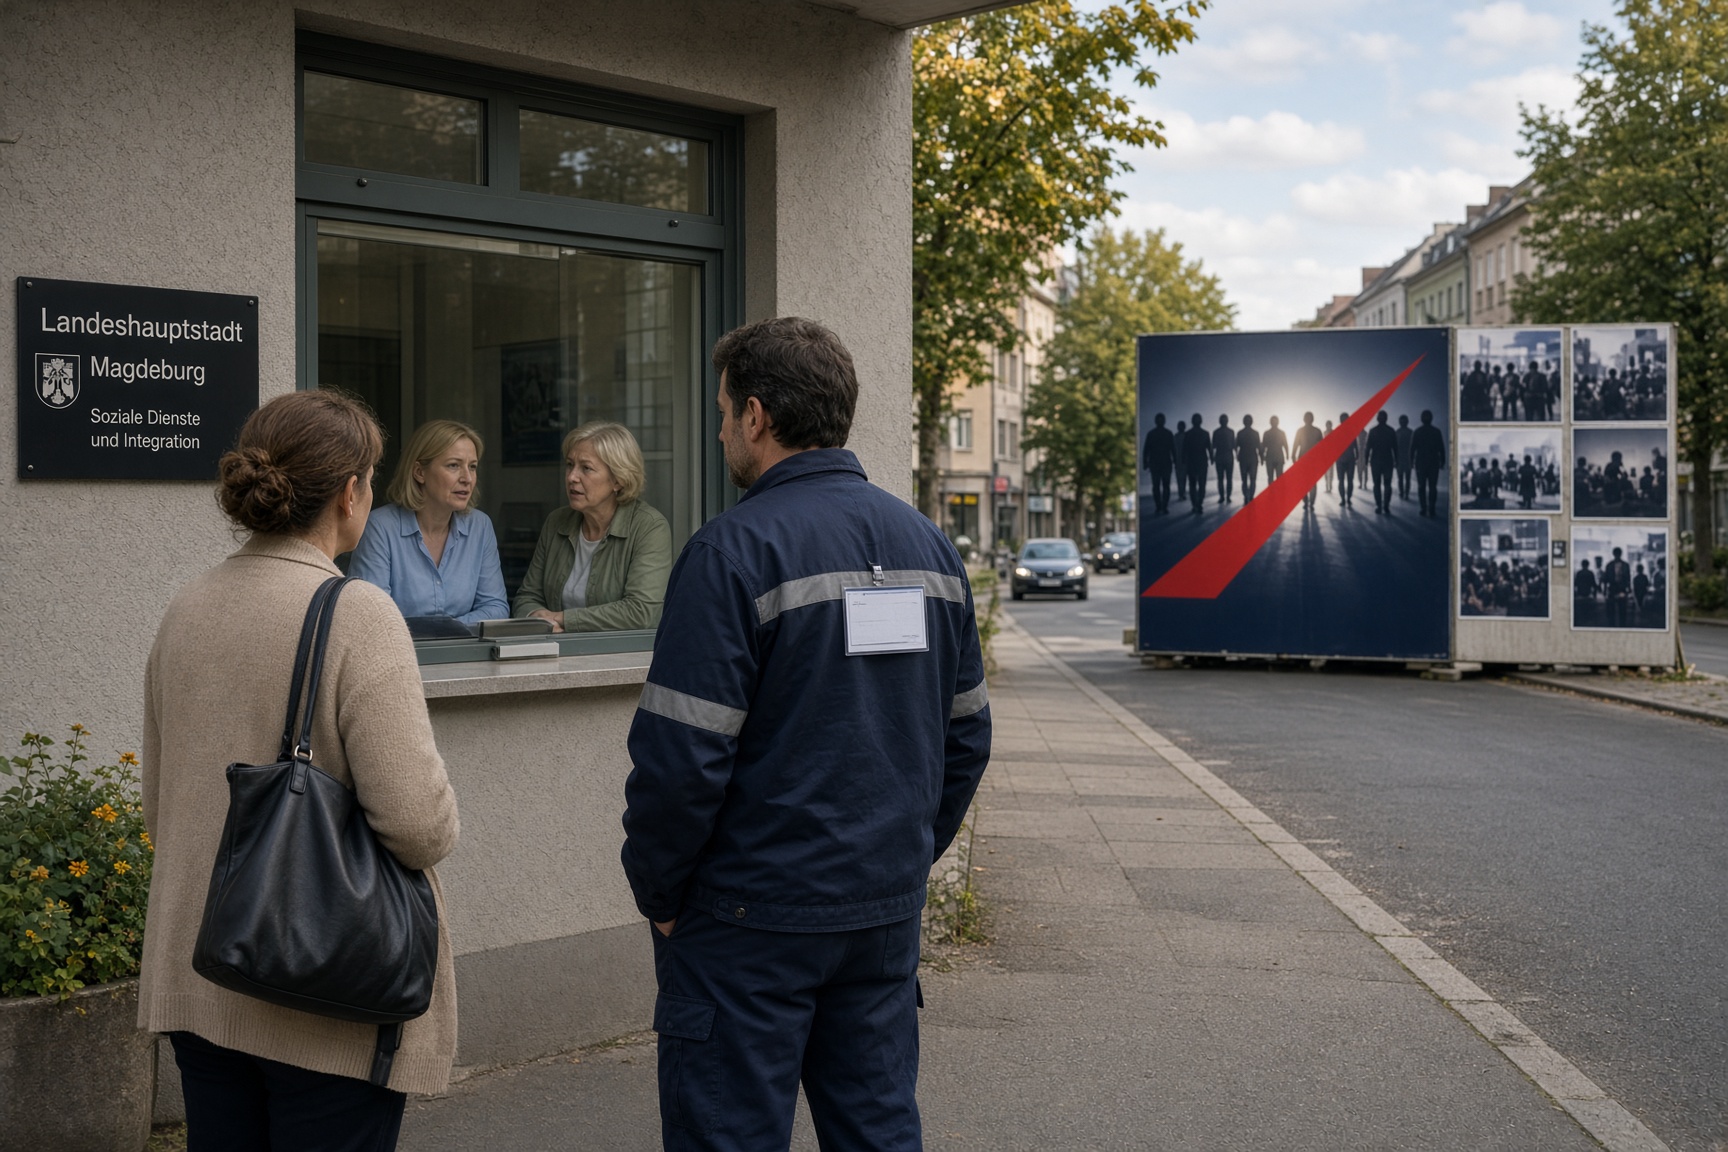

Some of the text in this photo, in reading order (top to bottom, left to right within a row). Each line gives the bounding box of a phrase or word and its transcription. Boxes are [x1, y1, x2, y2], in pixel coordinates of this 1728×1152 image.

[41, 307, 243, 344] Landeshauptstadt
[91, 355, 205, 386] Magdeburg
[90, 408, 201, 426] Soziale Dienste
[91, 432, 200, 451] und Integration
